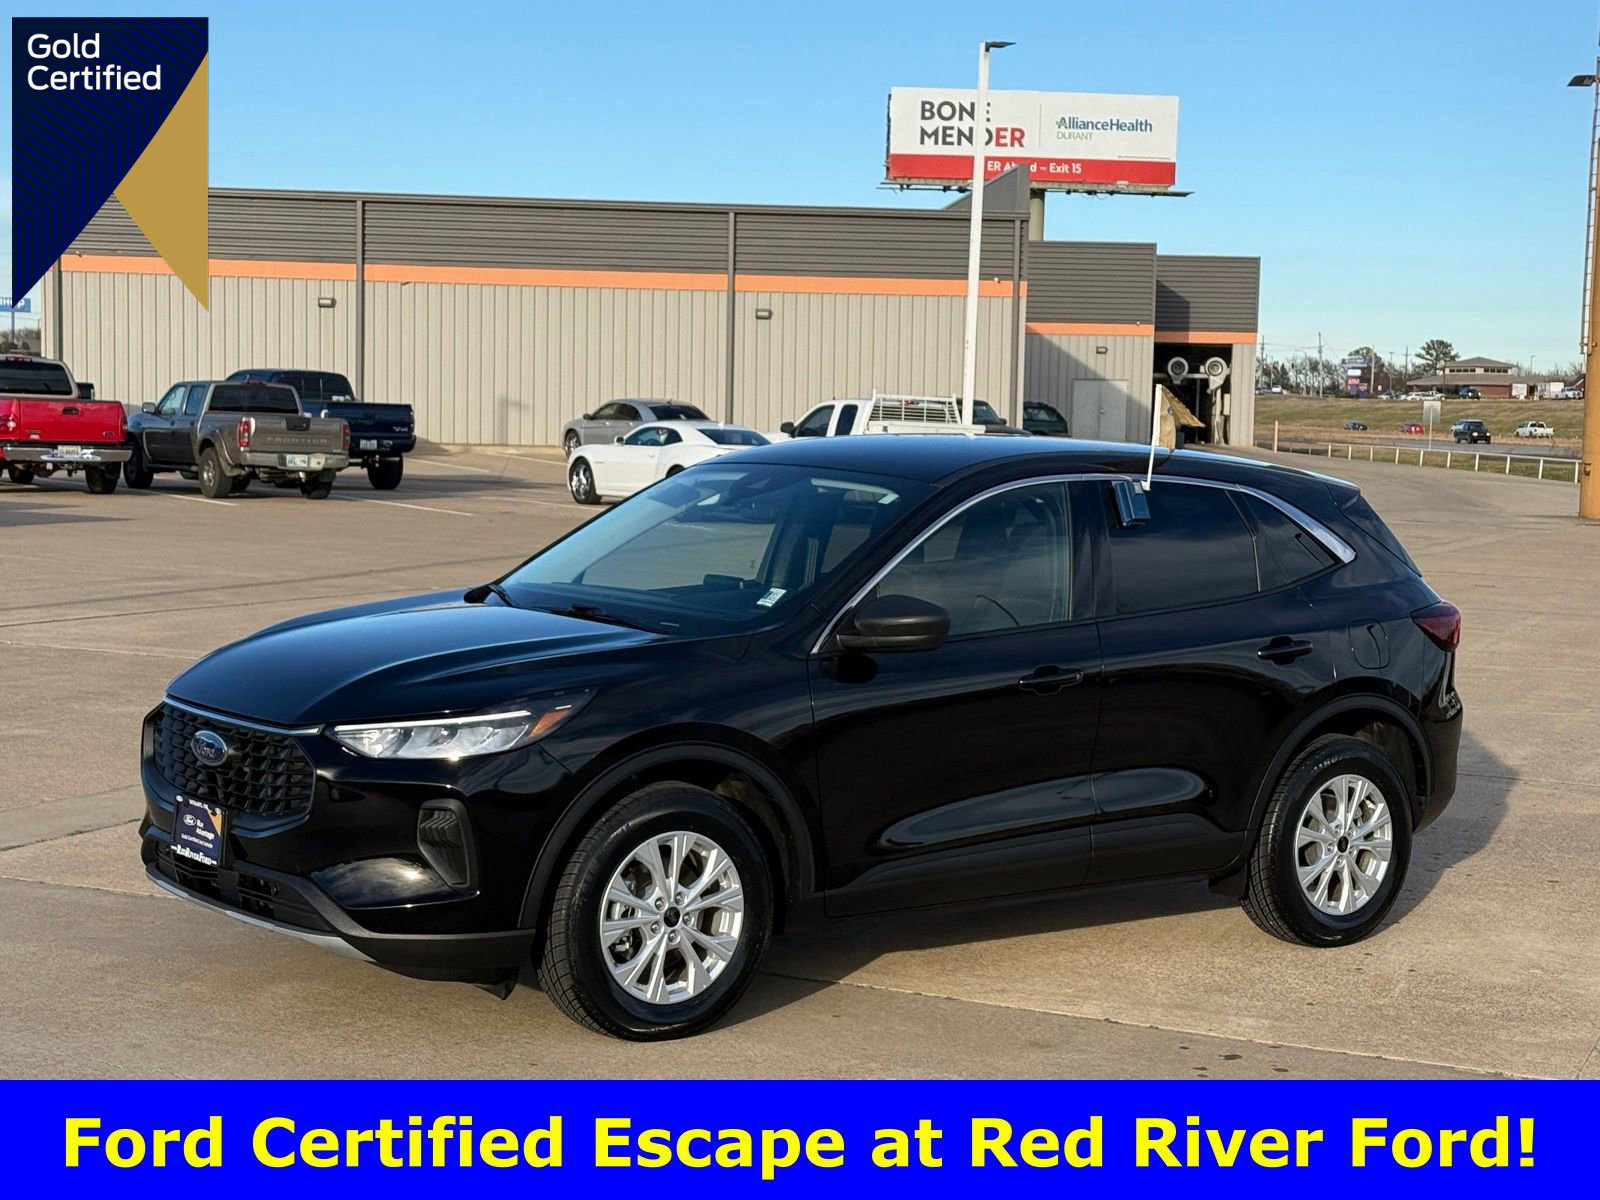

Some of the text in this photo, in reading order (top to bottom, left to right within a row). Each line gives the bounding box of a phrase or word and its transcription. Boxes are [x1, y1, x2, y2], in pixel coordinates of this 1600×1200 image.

[920, 100, 992, 122] BON
[1056, 117, 1153, 132] AllianceHealth
[1056, 131, 1094, 140] DURANT
[987, 161, 1001, 171] ER
[1049, 163, 1069, 173] Exit
[1072, 163, 1082, 174] 15
[196, 740, 216, 759] Ford
